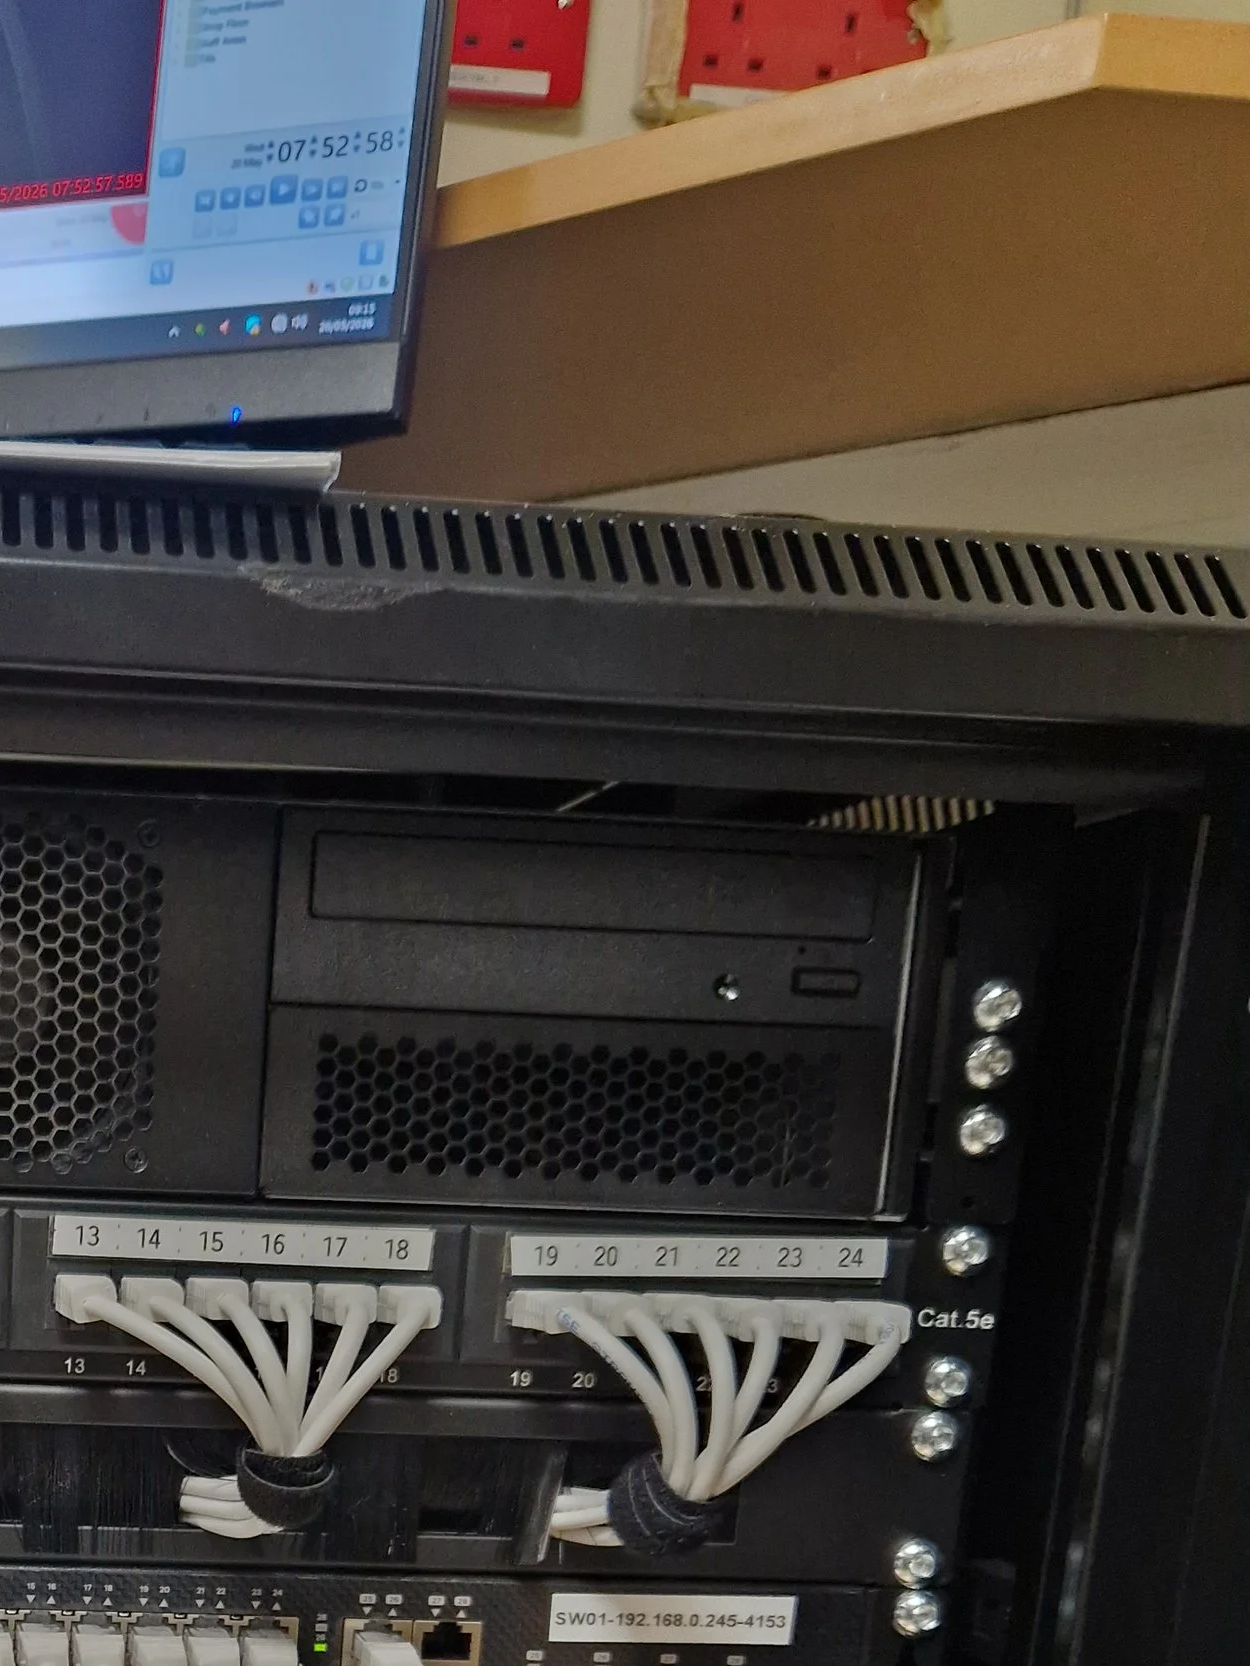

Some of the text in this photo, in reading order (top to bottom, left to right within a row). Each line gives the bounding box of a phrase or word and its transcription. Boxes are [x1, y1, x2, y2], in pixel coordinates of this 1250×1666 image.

[278, 139, 306, 162] 07
[322, 135, 349, 158] 52
[366, 130, 393, 153] 58
[52, 173, 143, 197] 07:52:57.589
[77, 1226, 408, 1259] 13 14 15 16 17 18
[536, 1246, 862, 1267] 19 20 21 22 23 24
[918, 1310, 995, 1330] Cat.5e
[65, 1358, 145, 1375] 13 14
[511, 1371, 594, 1388] 19 20
[555, 1612, 786, 1629] SW01-192.168.0.245-4153
